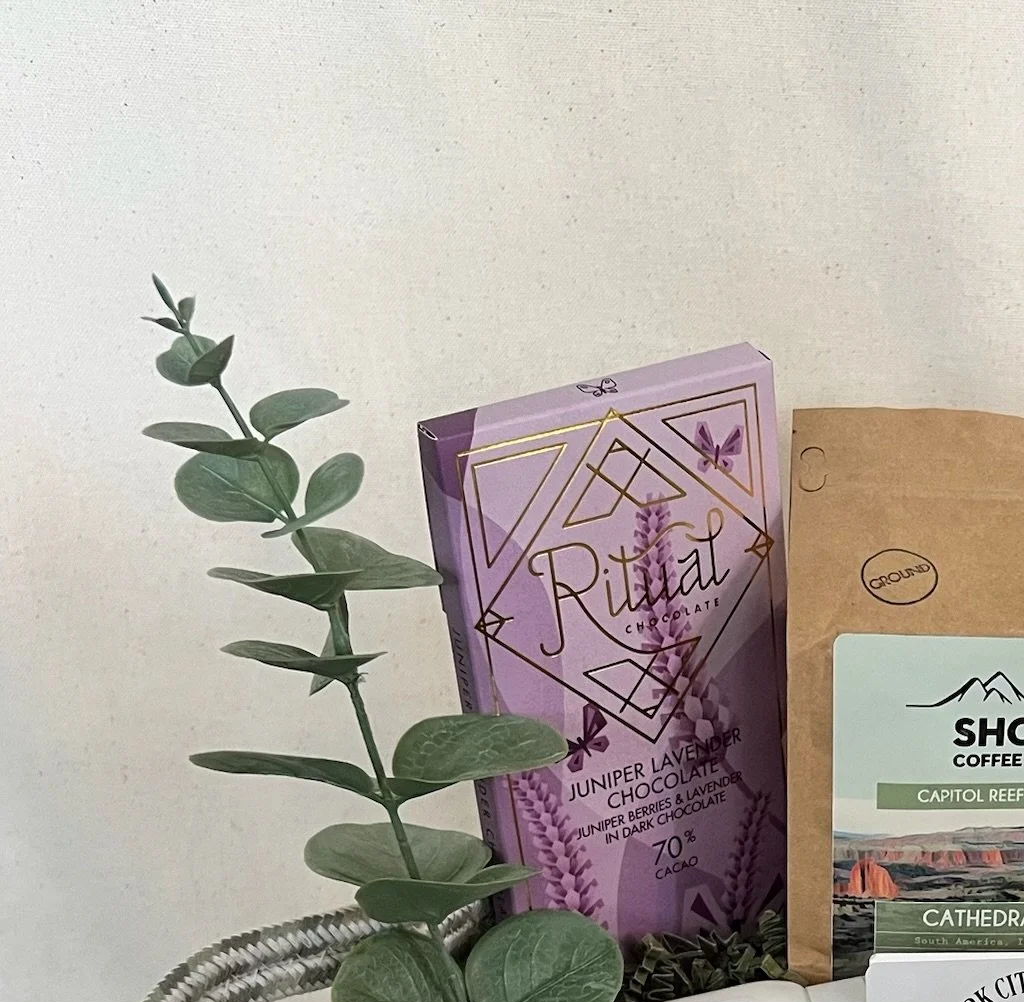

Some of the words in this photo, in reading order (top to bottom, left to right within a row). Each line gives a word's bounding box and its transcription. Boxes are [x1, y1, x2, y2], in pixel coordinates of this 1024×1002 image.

[528, 508, 731, 655] Ritual
[869, 563, 931, 590] GROUND
[625, 598, 721, 634] CHOCOLATE
[452, 626, 473, 711] JUNIPER
[569, 762, 645, 802] JUNIPER
[651, 728, 742, 773] LAVENDER
[952, 753, 1022, 768] COFFEE
[607, 757, 720, 809] CHOCOLATE
[917, 788, 984, 803] CAPITOL
[989, 788, 1024, 802] REEF
[576, 814, 630, 841] JUNIPER
[628, 797, 672, 822] BERRIES
[675, 794, 684, 805] &
[686, 772, 742, 799] LAVENDER
[605, 830, 620, 844] IN
[622, 818, 654, 839] DARK
[657, 791, 727, 825] CHOCOLATE
[655, 856, 698, 880] CACAO
[914, 936, 949, 946] South
